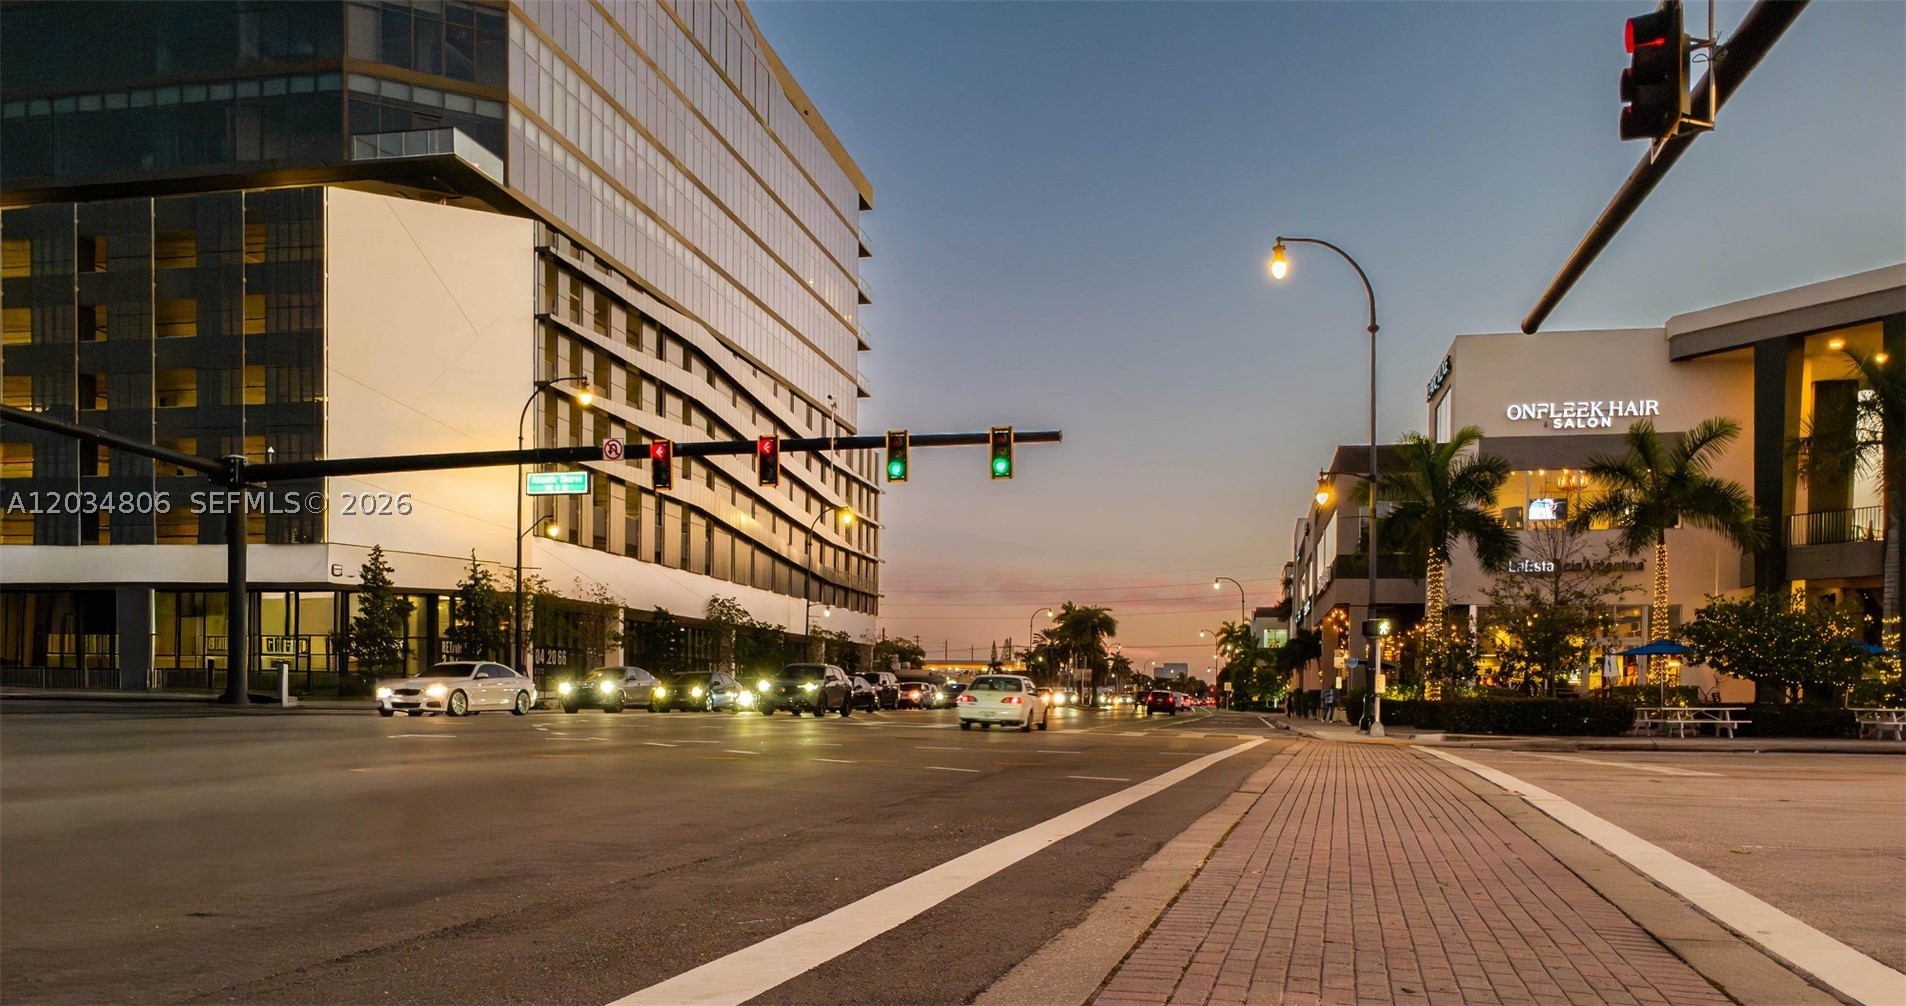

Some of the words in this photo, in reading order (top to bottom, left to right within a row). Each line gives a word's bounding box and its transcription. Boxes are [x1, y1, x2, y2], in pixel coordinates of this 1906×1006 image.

[1506, 400, 1604, 421] ONFLEEK
[1608, 399, 1660, 417] HAIR
[1553, 416, 1612, 429] SALON
